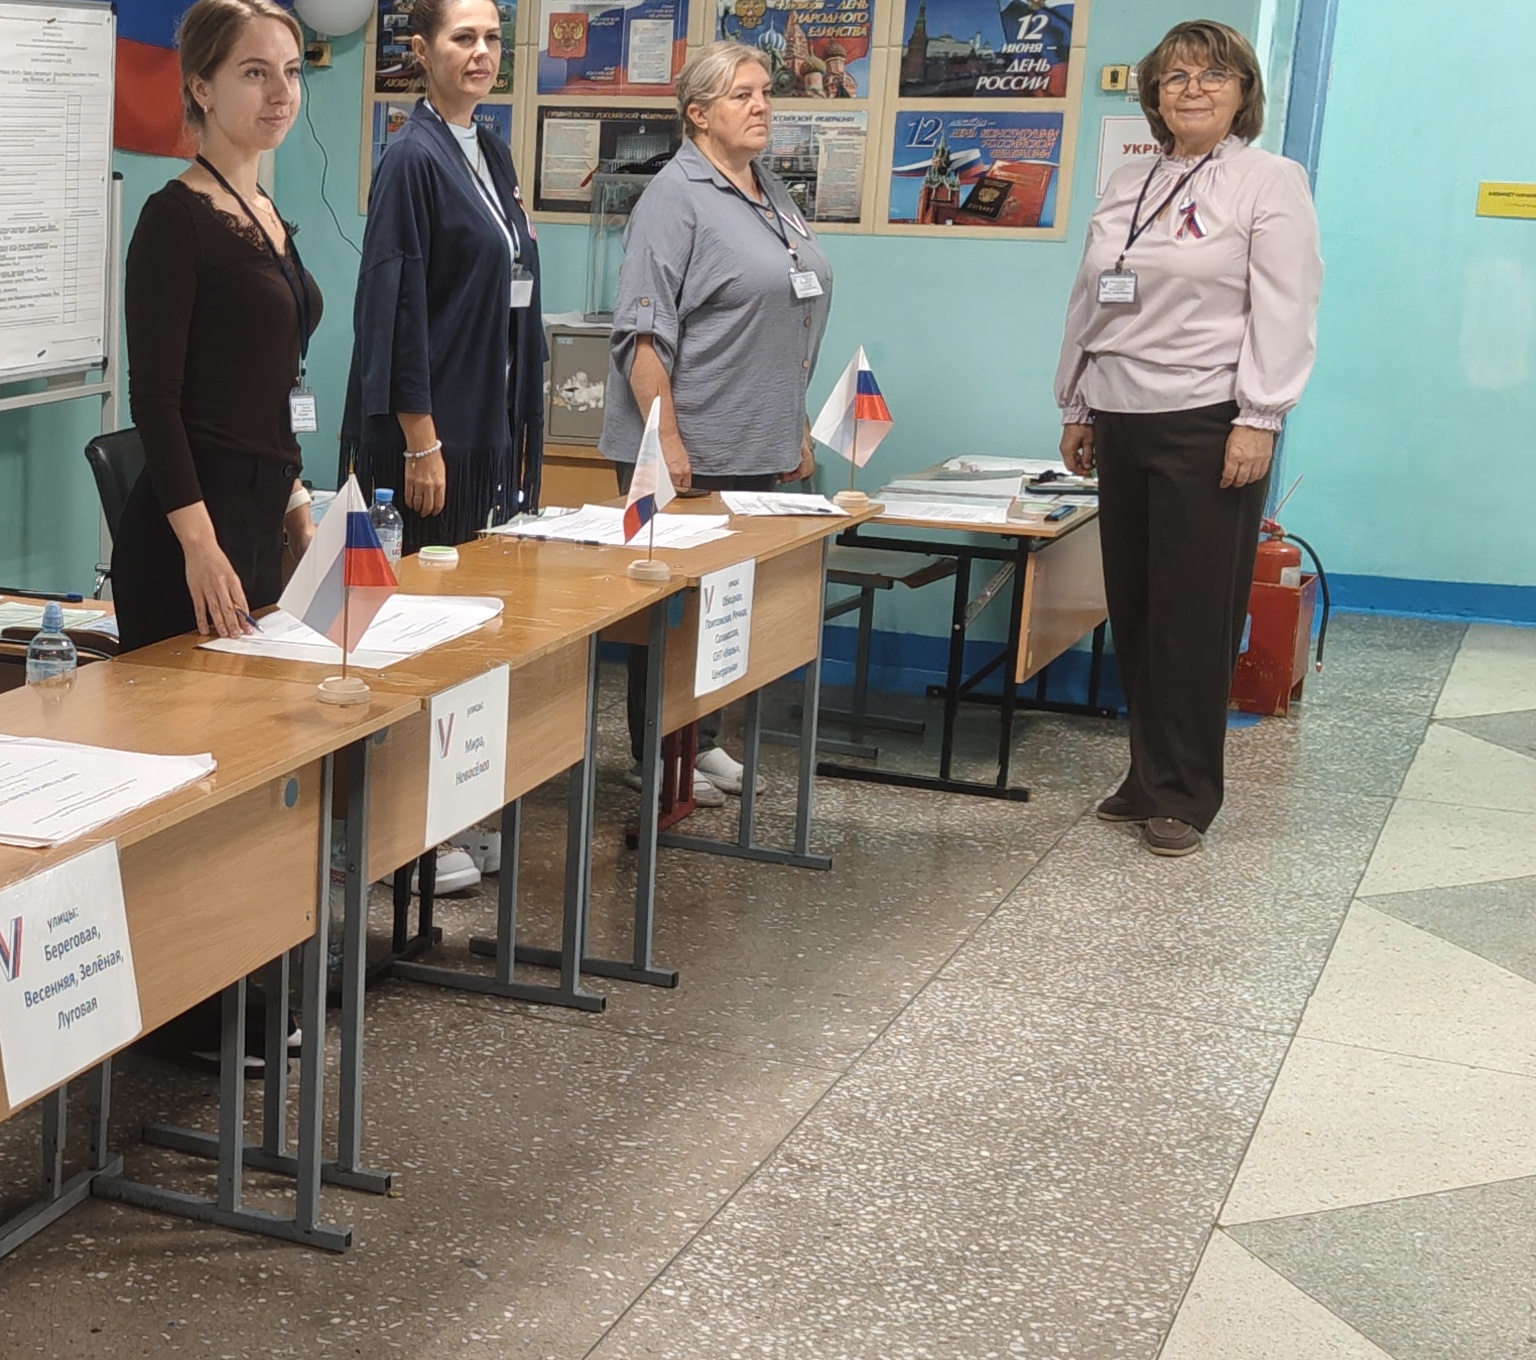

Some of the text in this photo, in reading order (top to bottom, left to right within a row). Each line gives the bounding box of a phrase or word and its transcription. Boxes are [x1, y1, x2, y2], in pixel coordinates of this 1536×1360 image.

[793, 12, 869, 24] НАРОДНОГО
[1016, 14, 1049, 40] 12
[807, 26, 868, 38] ЕДИНСТВА
[1001, 43, 1043, 53] июня
[1006, 58, 1051, 73] ДЕНЬ
[976, 76, 1051, 90] РОССИИ
[906, 116, 943, 148] 12
[47, 906, 79, 933] улицы:
[44, 925, 101, 962] Береговая,
[24, 948, 124, 1008] Весенняя, Зелёная,
[57, 997, 98, 1030] Луговая
